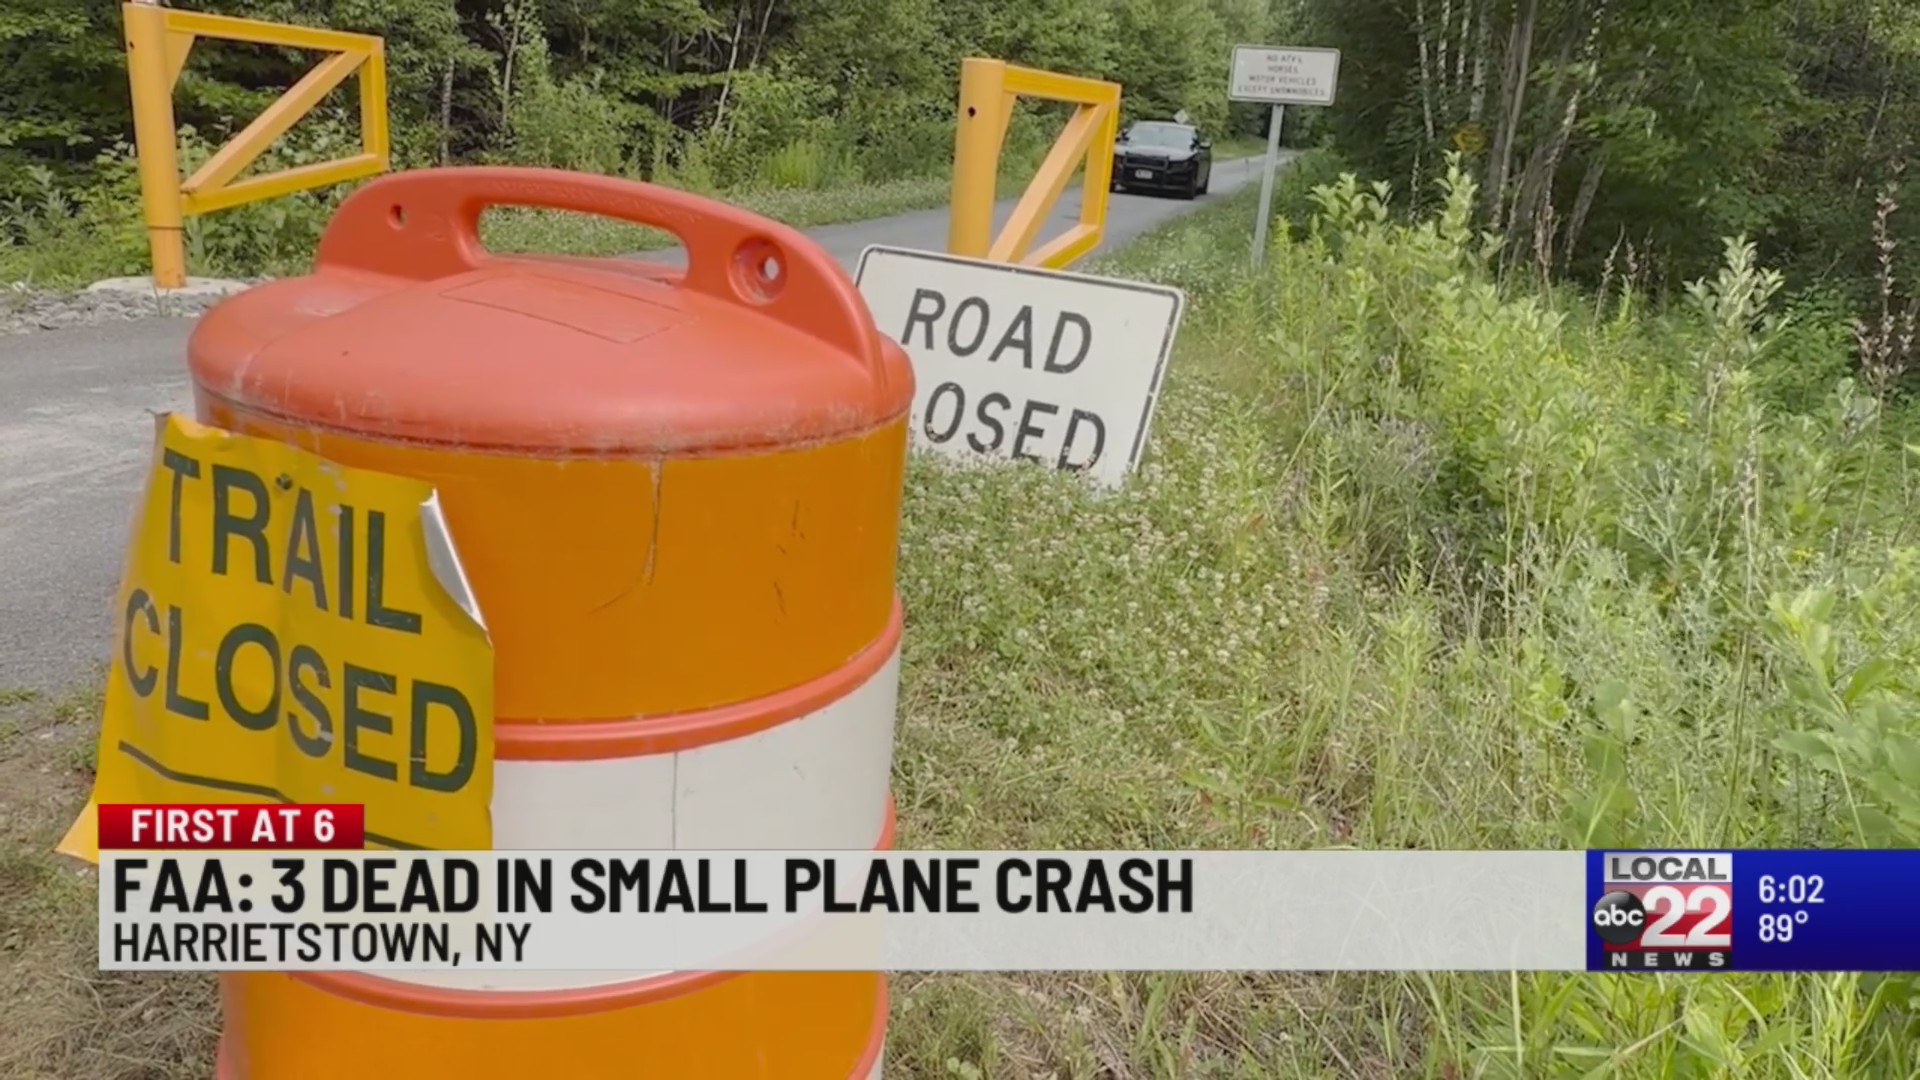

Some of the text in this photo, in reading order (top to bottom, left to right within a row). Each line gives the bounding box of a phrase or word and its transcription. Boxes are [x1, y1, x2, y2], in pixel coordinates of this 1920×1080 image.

[1238, 85, 1325, 97] EXCEPT SNOWMOBILES
[1248, 75, 1317, 86] MOTOR VEHICLES
[1267, 65, 1299, 73] HORSES
[901, 287, 1091, 374] ROAD
[923, 382, 1106, 473] OSED
[163, 447, 422, 634] TRAIL
[124, 588, 477, 792] CLOSED
